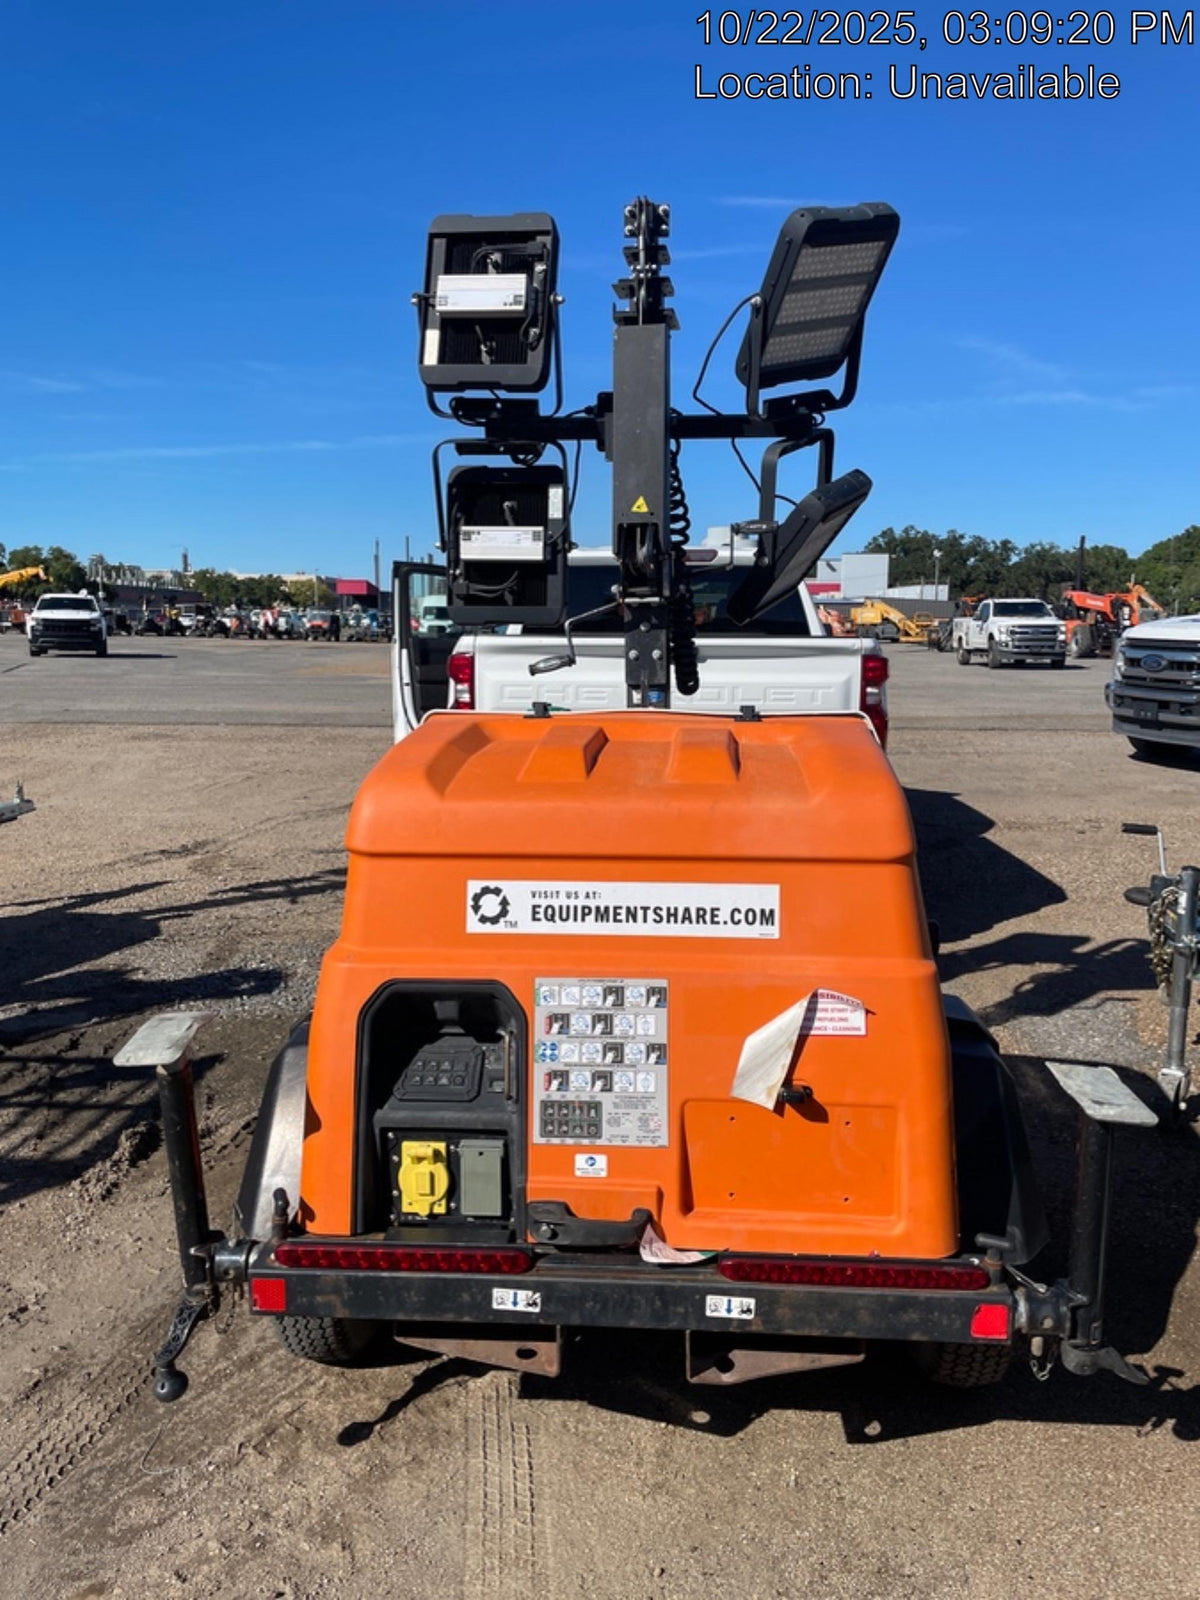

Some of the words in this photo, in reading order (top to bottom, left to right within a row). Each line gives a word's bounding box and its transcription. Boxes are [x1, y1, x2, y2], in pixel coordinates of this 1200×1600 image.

[500, 683, 833, 705] CHEOLET
[530, 890, 561, 900] VISIT
[565, 890, 580, 900] US
[584, 891, 603, 900] AT:
[531, 904, 776, 926] EQUIPMENTSHARE.COM
